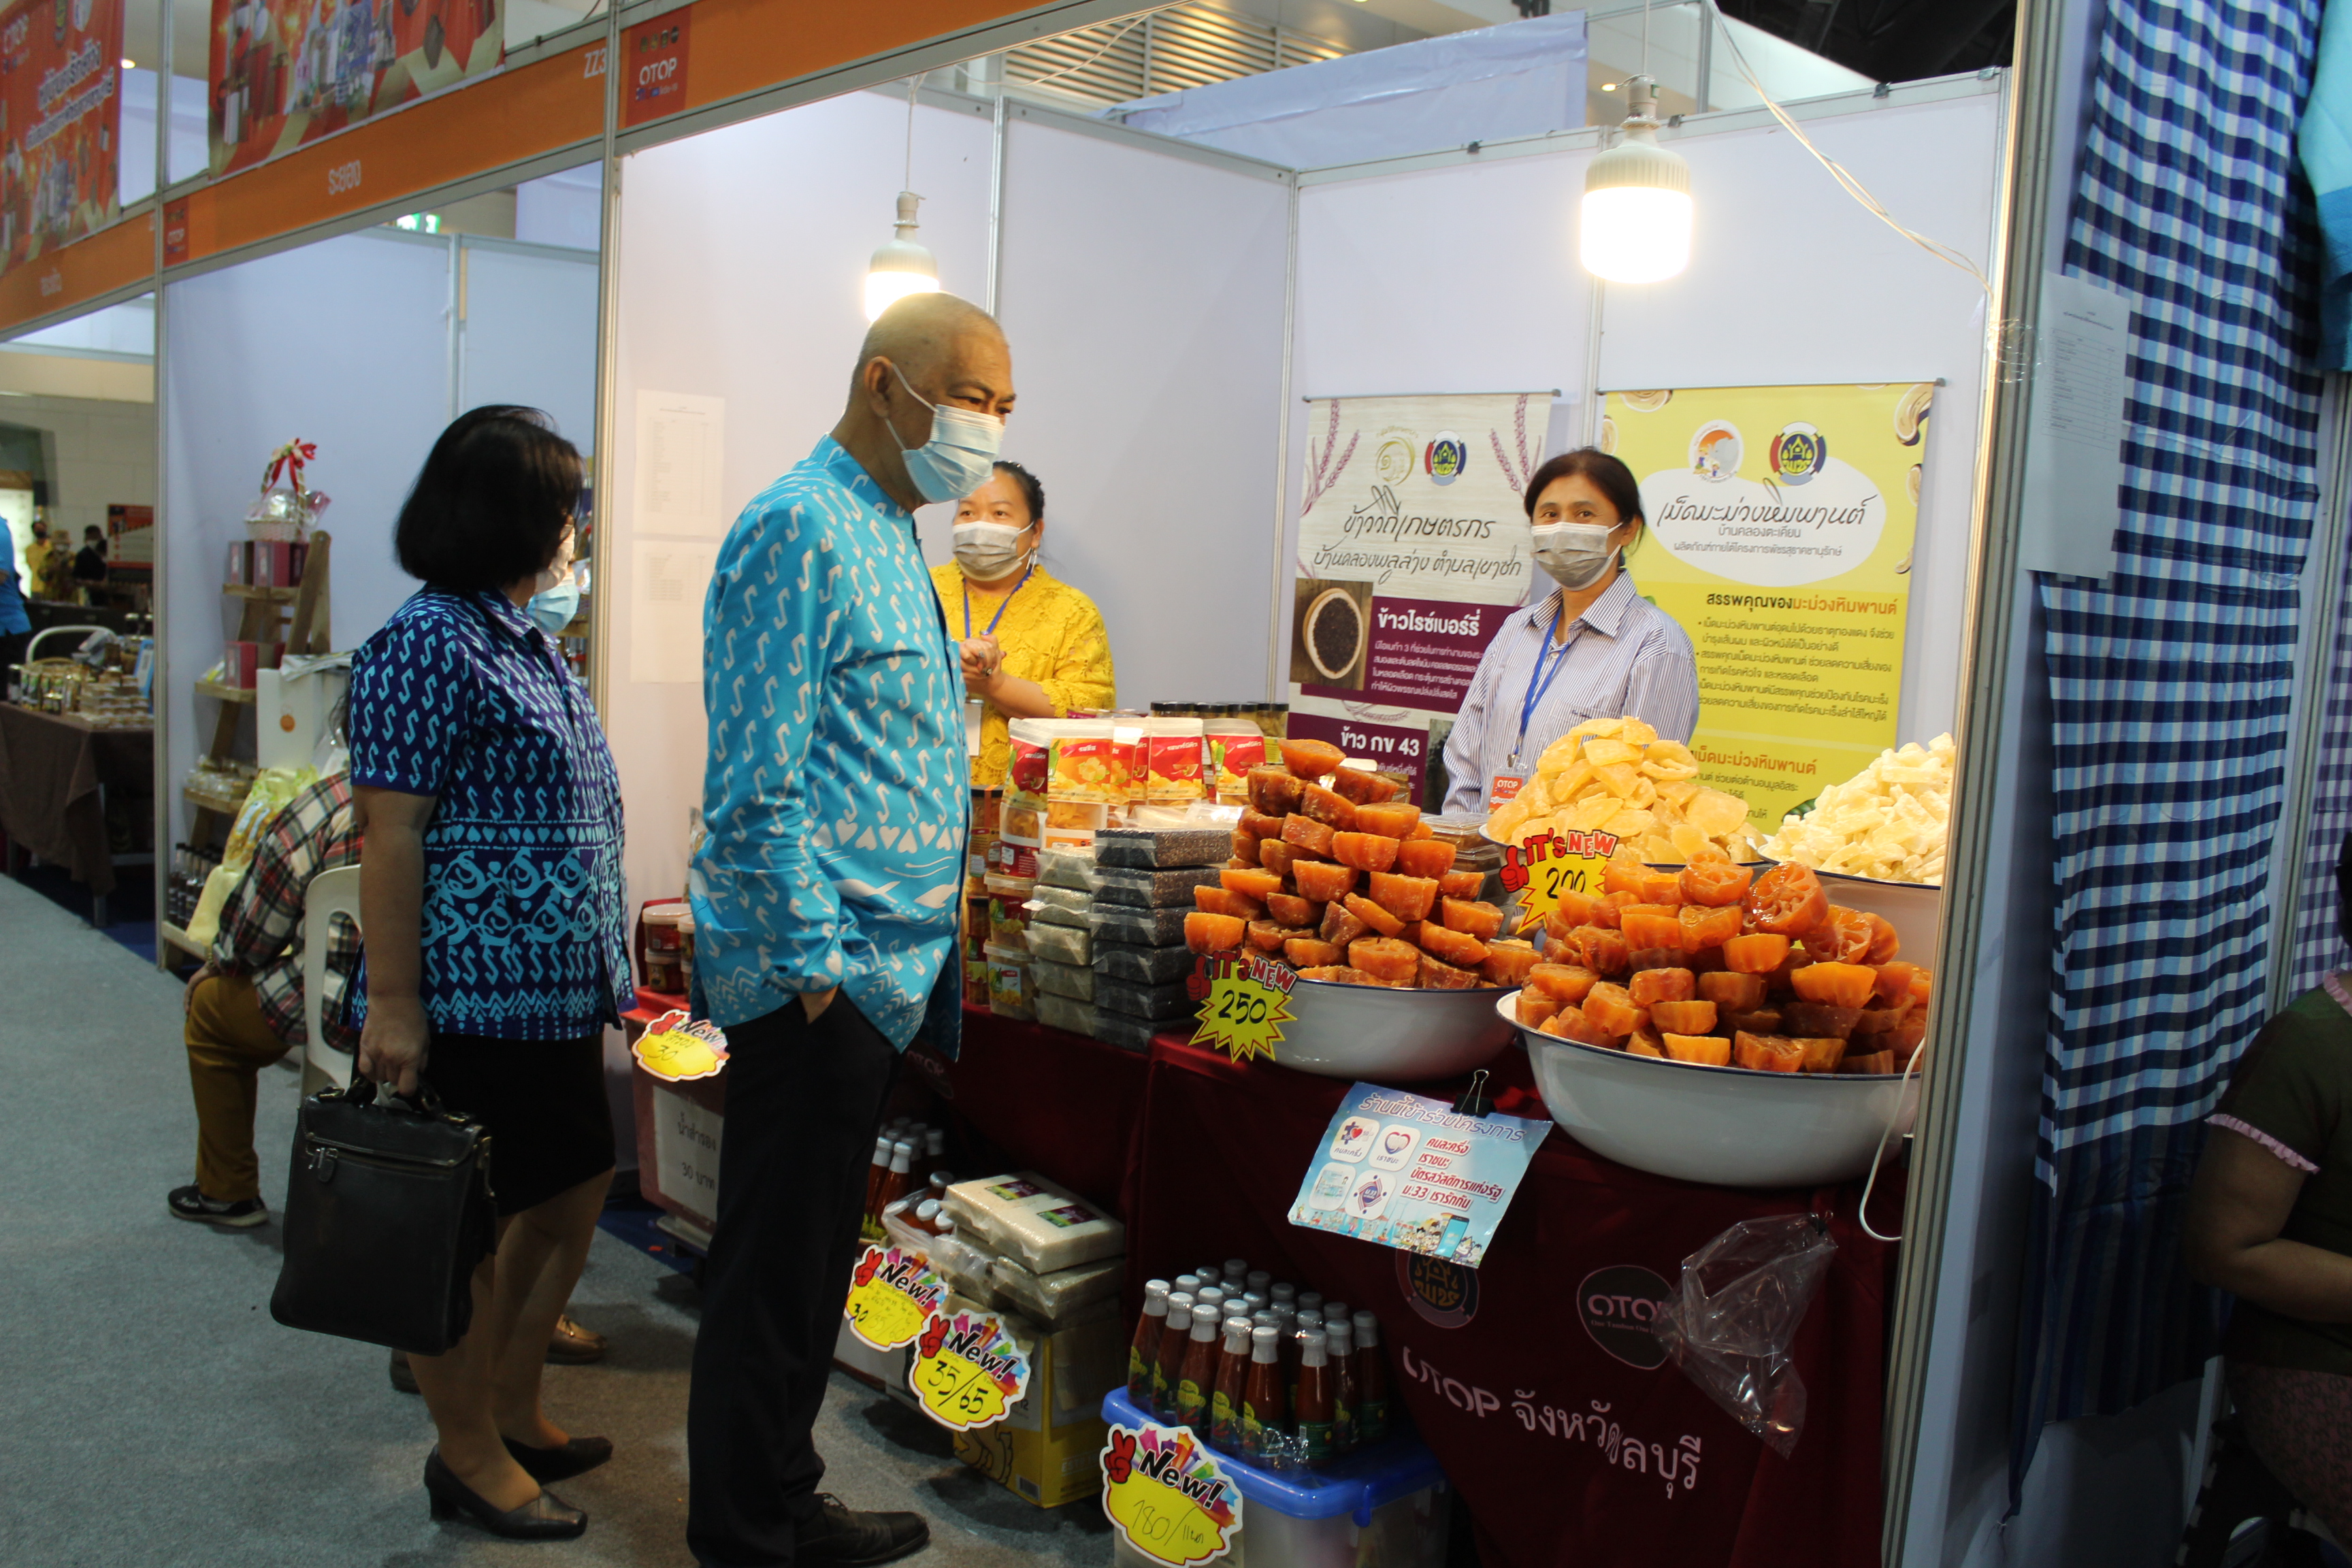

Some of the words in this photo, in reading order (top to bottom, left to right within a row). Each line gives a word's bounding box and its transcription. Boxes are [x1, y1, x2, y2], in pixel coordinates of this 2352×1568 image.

[639, 56, 678, 86] OTOP
[1377, 608, 1481, 637] ข้าวไรซ์เบอร์รี่
[1341, 725, 1367, 749] ข้าว
[1371, 736, 1395, 753] กข
[1398, 738, 1420, 757] 43
[1690, 745, 1818, 775] เม็ดมะม่วงหิมพานต์
[1497, 779, 1519, 789] OTOP
[1566, 829, 1619, 860] NEW
[1249, 955, 1300, 995] NEW
[1218, 990, 1267, 1025] 250
[647, 1045, 679, 1062] 30
[1334, 1147, 1362, 1158] คนละครึ่ง
[1418, 1153, 1450, 1166] เราชนะ
[1426, 1138, 1470, 1154] คนละครึ่ง
[682, 1162, 693, 1180] 30
[1410, 1166, 1503, 1200] บัตรสวัสดิการแห่งรัฐ
[1401, 1185, 1429, 1198] ม.33
[1429, 1191, 1472, 1209] เรารักกัน
[879, 1262, 941, 1307] New!
[947, 1330, 1021, 1381] New!
[1137, 1449, 1227, 1510] New!
